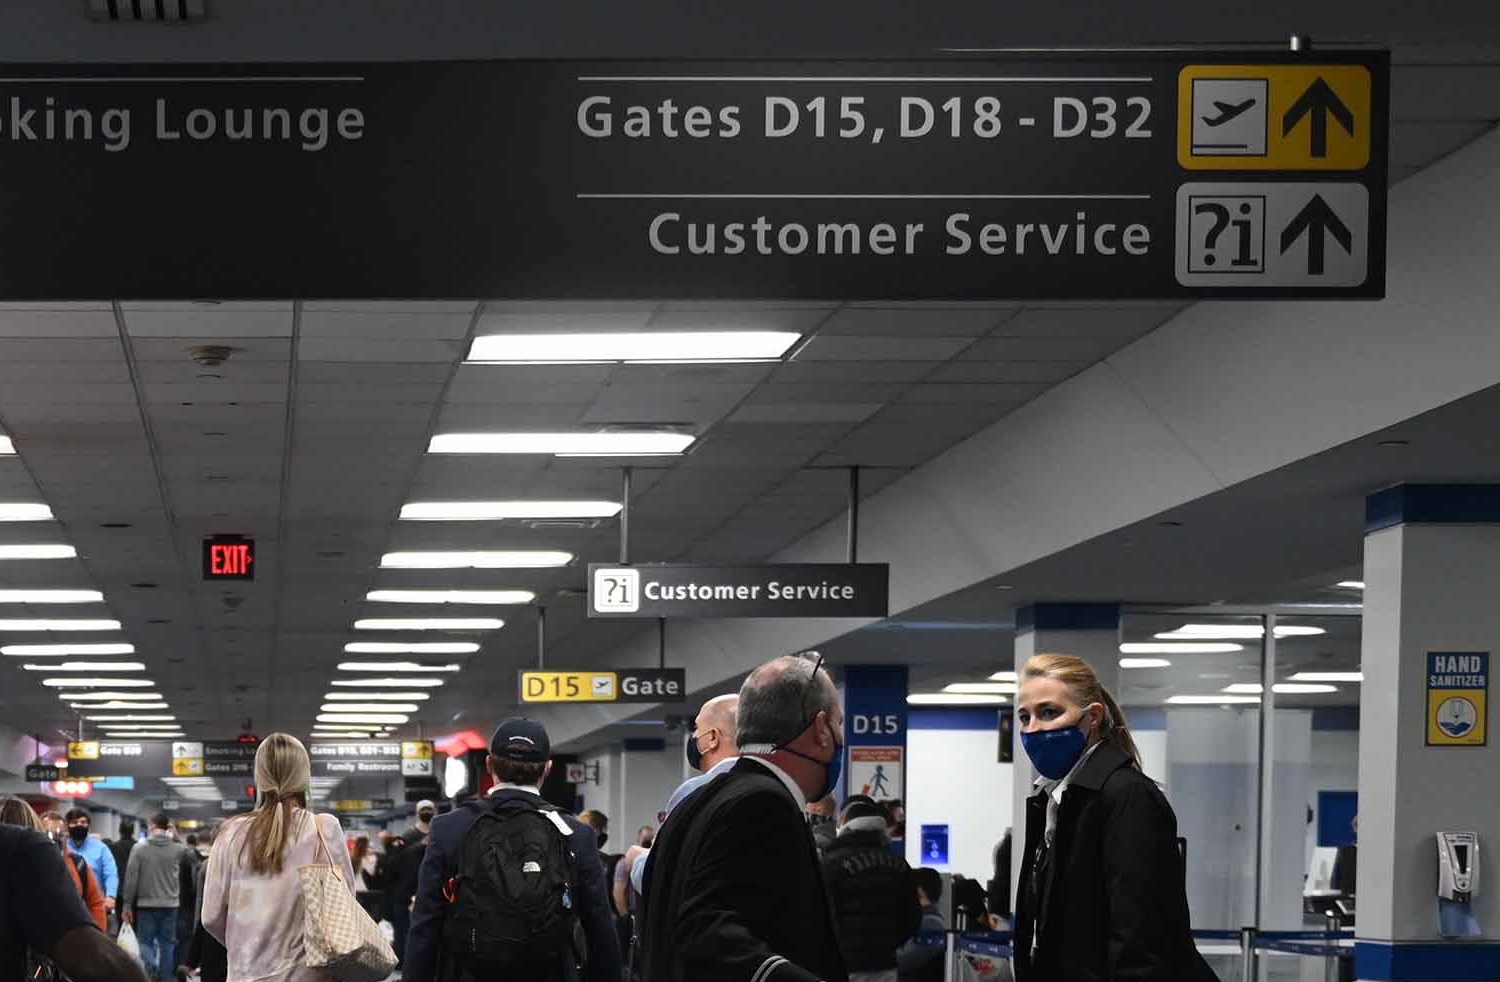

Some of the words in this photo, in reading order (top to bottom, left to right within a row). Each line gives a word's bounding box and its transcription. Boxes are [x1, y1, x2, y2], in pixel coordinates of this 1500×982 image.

[155, 97, 366, 152] Lounge
[576, 95, 742, 139] Gates
[764, 96, 886, 145] D15,
[899, 96, 1003, 139] D18
[1052, 96, 1153, 139] D32
[648, 211, 925, 256] Customer
[944, 211, 1151, 256] Service
[211, 544, 249, 575] EXIT
[644, 581, 760, 601] Customer
[767, 581, 854, 601] Service
[1434, 655, 1482, 674] HAND
[526, 676, 581, 698] D15
[621, 676, 680, 696] Gate
[1429, 674, 1486, 688] SANITIZER
[852, 714, 899, 735] D15
